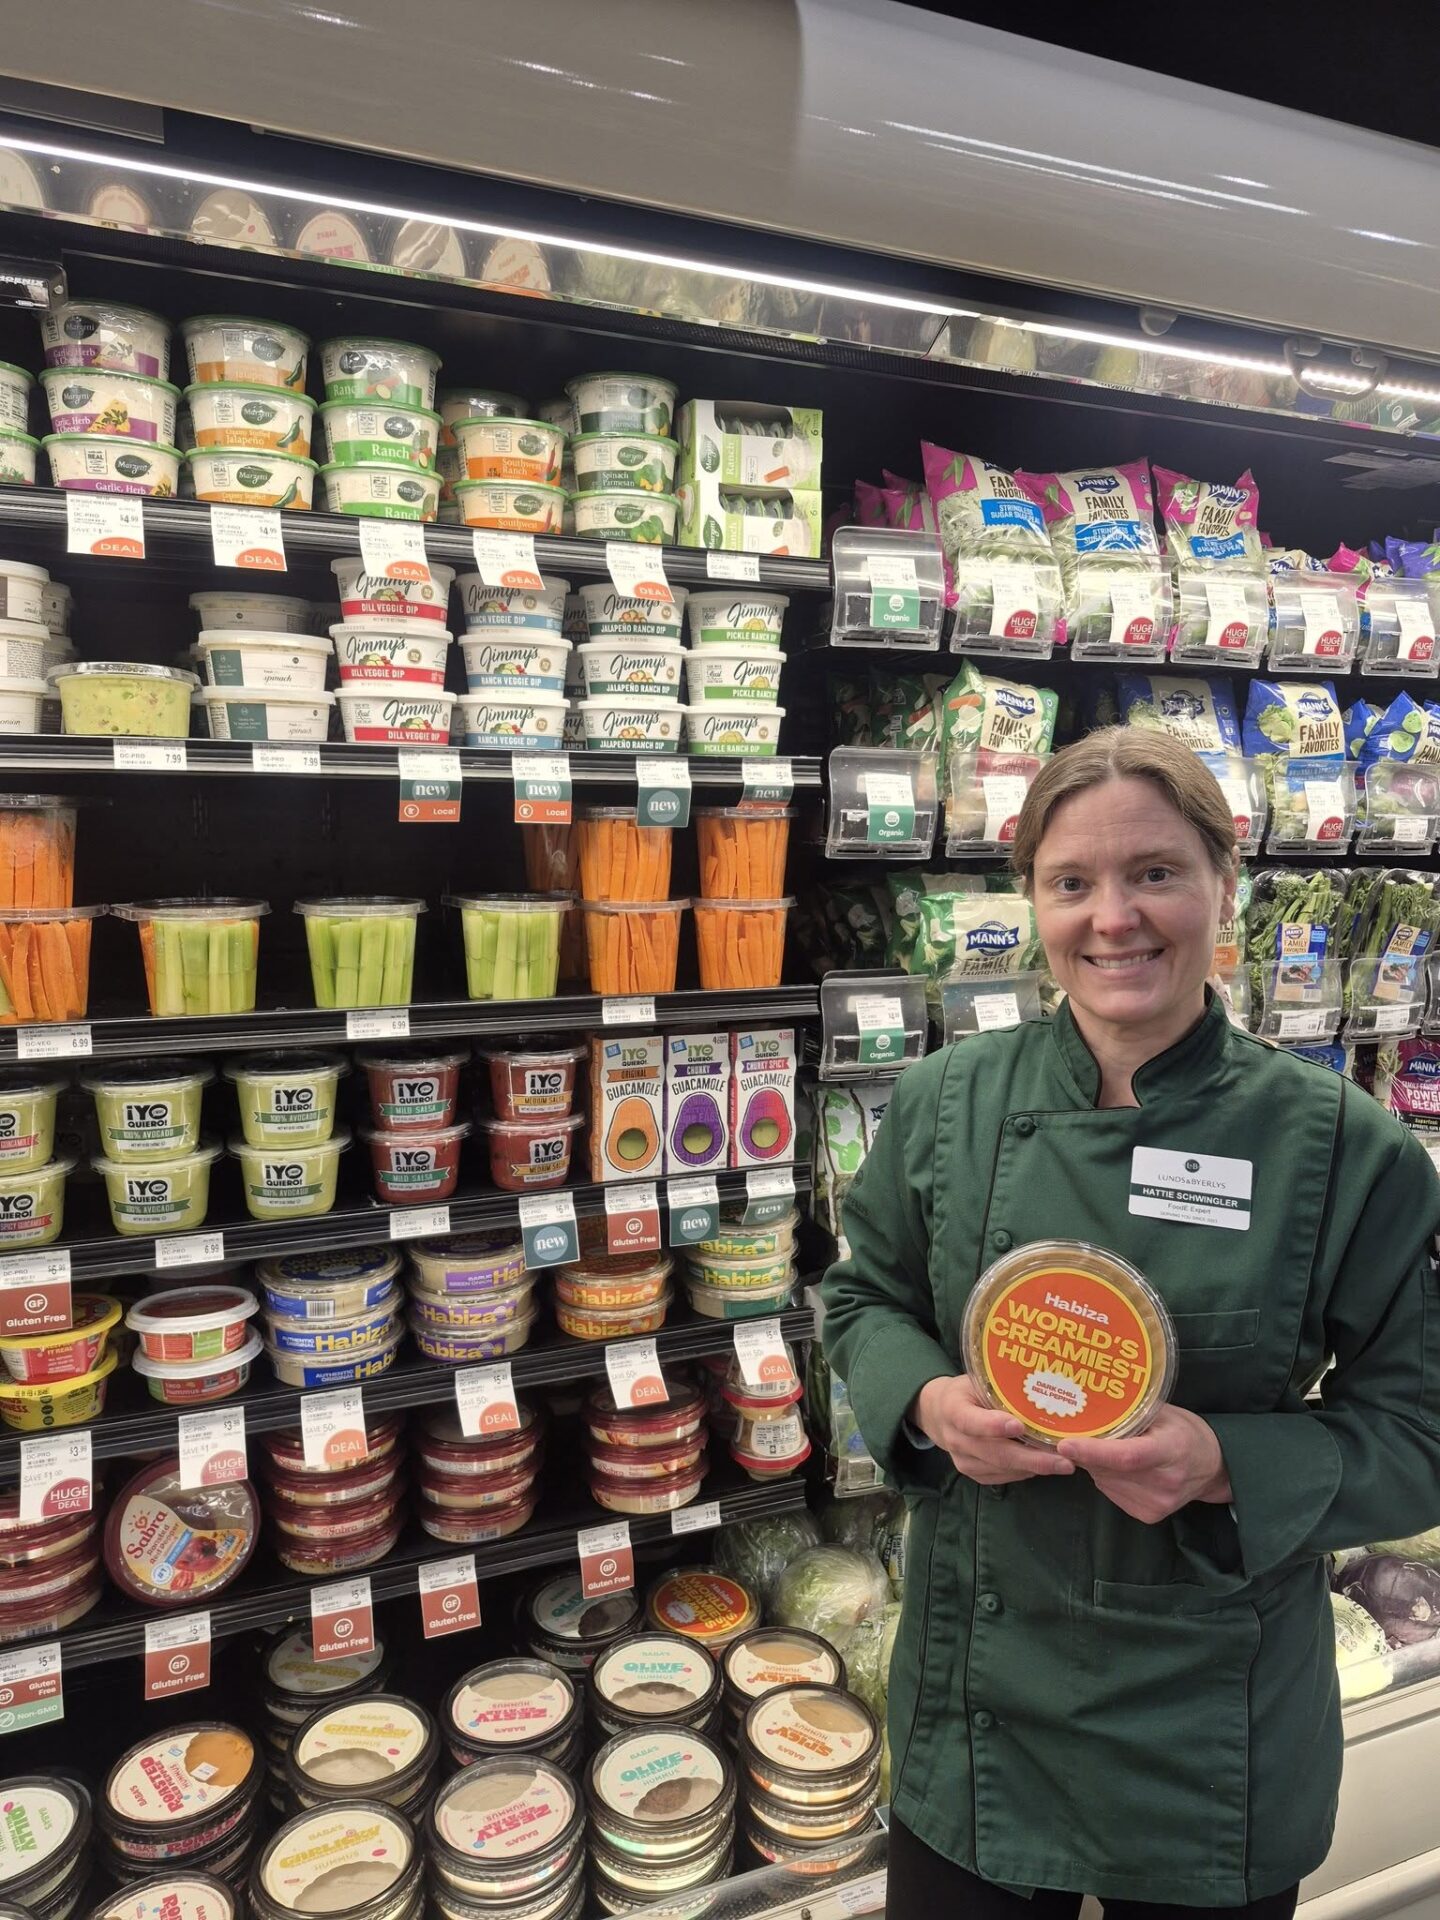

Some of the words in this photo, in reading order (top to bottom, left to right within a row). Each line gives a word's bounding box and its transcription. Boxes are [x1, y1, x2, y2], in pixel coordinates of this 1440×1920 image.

[371, 444, 410, 460] Ranch
[238, 474, 270, 488] Marzetti
[1079, 478, 1116, 490] MANN'S
[96, 483, 121, 494] Garlic,
[125, 484, 146, 495] Herb
[1086, 497, 1125, 512] FAMILY
[384, 507, 420, 522] Ranch
[497, 519, 537, 531] Southwest
[101, 543, 137, 553] DEAL
[244, 557, 281, 568] DEAL
[362, 603, 379, 612] DILL
[380, 603, 404, 613] VEGGIE
[405, 605, 420, 614] DIP
[488, 616, 513, 625] VEGGIE
[514, 617, 526, 625] DIP
[884, 614, 910, 625] Organic
[1011, 617, 1036, 629] HUGE
[601, 623, 631, 633] JALAPEÑO
[633, 625, 655, 633] RANCH
[1130, 624, 1153, 635] HUGE
[1226, 628, 1248, 639] HUGE
[727, 632, 749, 640] PICKLE
[346, 637, 407, 664] Jimmy's
[480, 646, 538, 673] Jimmy's
[352, 669, 366, 678] DILL
[366, 669, 390, 679] VEGGIE
[391, 670, 406, 679] DIP
[610, 654, 666, 681] Jimmy's
[481, 676, 503, 685] RANCH
[503, 677, 528, 687] VEGGIE
[529, 678, 542, 687] DIP
[607, 682, 639, 693] JALAPEÑO
[640, 685, 661, 694] RANCH
[733, 689, 755, 698] PICKLE
[382, 699, 443, 725] Jimmy's
[1298, 700, 1331, 714] MANN'S
[476, 705, 535, 732] Jimmy's
[603, 711, 659, 739] Jimmy's
[388, 731, 404, 739] DILL
[405, 732, 428, 740] VEGGIE
[703, 715, 759, 742] Jimmy's
[1300, 723, 1339, 742] FAMILY
[477, 736, 498, 745] RANCH
[499, 737, 526, 745] VEGGIE
[527, 738, 538, 746] DIP
[600, 739, 629, 749] JALAPEÑO
[630, 741, 653, 749] RANCH
[704, 744, 724, 753] PICKLE
[1299, 739, 1340, 759] FAVORITES
[166, 753, 182, 764] 7.99
[415, 784, 449, 797] new
[528, 785, 560, 797] new
[755, 789, 782, 800] new
[433, 808, 456, 816] Local
[546, 809, 568, 817] Local
[650, 801, 679, 812] new
[878, 829, 905, 840] Organic
[1323, 822, 1343, 833] HUGE
[969, 931, 1017, 948] MANN'S
[1284, 939, 1308, 948] FAMILY
[962, 953, 1016, 973] FAMILY
[71, 1037, 88, 1048] 6.99
[869, 1051, 896, 1061] Organic
[686, 1065, 710, 1076] CHUNKY
[746, 1059, 767, 1072] CHUNKY
[768, 1058, 786, 1069] SPICY
[672, 1077, 727, 1096] GUACAMOLE
[740, 1073, 793, 1092] GUACAMOLE
[606, 1081, 661, 1102] GUACAMOLE
[398, 1096, 433, 1105] QUIERO!
[524, 1095, 548, 1105] MEDIUM
[275, 1103, 312, 1112] QUIERO!
[395, 1105, 413, 1115] MILD
[415, 1104, 437, 1114] SALSA
[289, 1111, 318, 1121] AVOCADO
[127, 1119, 168, 1130] QUIERO!
[143, 1128, 174, 1138] AVOCADO
[395, 1164, 431, 1173] QUIERO!
[265, 1178, 303, 1188] QUIERO!
[393, 1173, 410, 1183] MILD
[412, 1172, 434, 1182] SALSA
[1158, 1174, 1226, 1190] LUNDS&BYERLYS
[280, 1187, 309, 1196] AVOCADO
[1143, 1187, 1175, 1200] HATTIE
[1176, 1192, 1239, 1209] SCHWINGLER
[128, 1194, 168, 1204] QUIERO!
[144, 1203, 175, 1213] AVOCADO
[757, 1205, 784, 1216] new
[1168, 1202, 1189, 1212] FoodE
[1190, 1206, 1212, 1216] Expert
[682, 1217, 710, 1231] new
[536, 1236, 566, 1252] new
[613, 1236, 640, 1248] Gluten
[641, 1235, 657, 1244] Free
[204, 1244, 220, 1255] 6.99
[704, 1267, 771, 1286] Habiza
[572, 1285, 645, 1306] Habiza
[28, 1299, 45, 1309] GF
[1044, 1291, 1110, 1325] Habiza
[6, 1316, 42, 1328] Gluten
[43, 1313, 67, 1323] Free
[422, 1304, 496, 1326] Habiza
[565, 1316, 634, 1336] Habiza
[1007, 1298, 1140, 1361] WORLD'S
[418, 1336, 483, 1360] Habiza
[988, 1316, 1150, 1385] CREAMIEST
[763, 1365, 789, 1377] DEAL
[996, 1340, 1126, 1400] HUMMUS
[636, 1386, 662, 1399] DEAL
[1031, 1385, 1049, 1397] BELL
[1049, 1392, 1078, 1407] PEPPER
[1036, 1380, 1057, 1392] DARK
[1057, 1388, 1077, 1399] CHILI
[484, 1413, 515, 1425] DEAL
[330, 1440, 359, 1455] DEAL
[208, 1457, 244, 1472] HUGE
[215, 1470, 236, 1479] DEAL
[50, 1484, 90, 1501] HUGE
[57, 1500, 81, 1510] DEAL
[126, 1510, 168, 1560] Sabra
[588, 1578, 613, 1590] Gluten
[613, 1575, 631, 1585] Free
[674, 1577, 733, 1628] CREAMIEST
[688, 1576, 739, 1621] WORLD'S
[429, 1617, 458, 1629] Gluten
[458, 1611, 476, 1622] Free
[318, 1638, 351, 1653] Gluten
[351, 1635, 370, 1647] Free
[623, 1662, 685, 1674] OLIVE
[28, 1678, 57, 1691] Gluten
[151, 1676, 185, 1690] Gluten
[185, 1671, 205, 1684] Free
[38, 1686, 57, 1697] Free
[17, 1703, 58, 1721] Non-GMO
[473, 1706, 548, 1725] ZESTY
[774, 1726, 834, 1757] SPICY
[154, 1760, 173, 1786] PEPPER
[620, 1752, 683, 1783] OLIVE
[169, 1763, 190, 1789] HUMMUS
[139, 1757, 185, 1814] ROASTED
[129, 1785, 148, 1808] BABA'S
[37, 1806, 53, 1831] BABA'S
[486, 1800, 527, 1823] HUMMUS
[8, 1804, 38, 1852] DILLY
[476, 1803, 552, 1843] ZESTY
[504, 1829, 539, 1848] BABA'S
